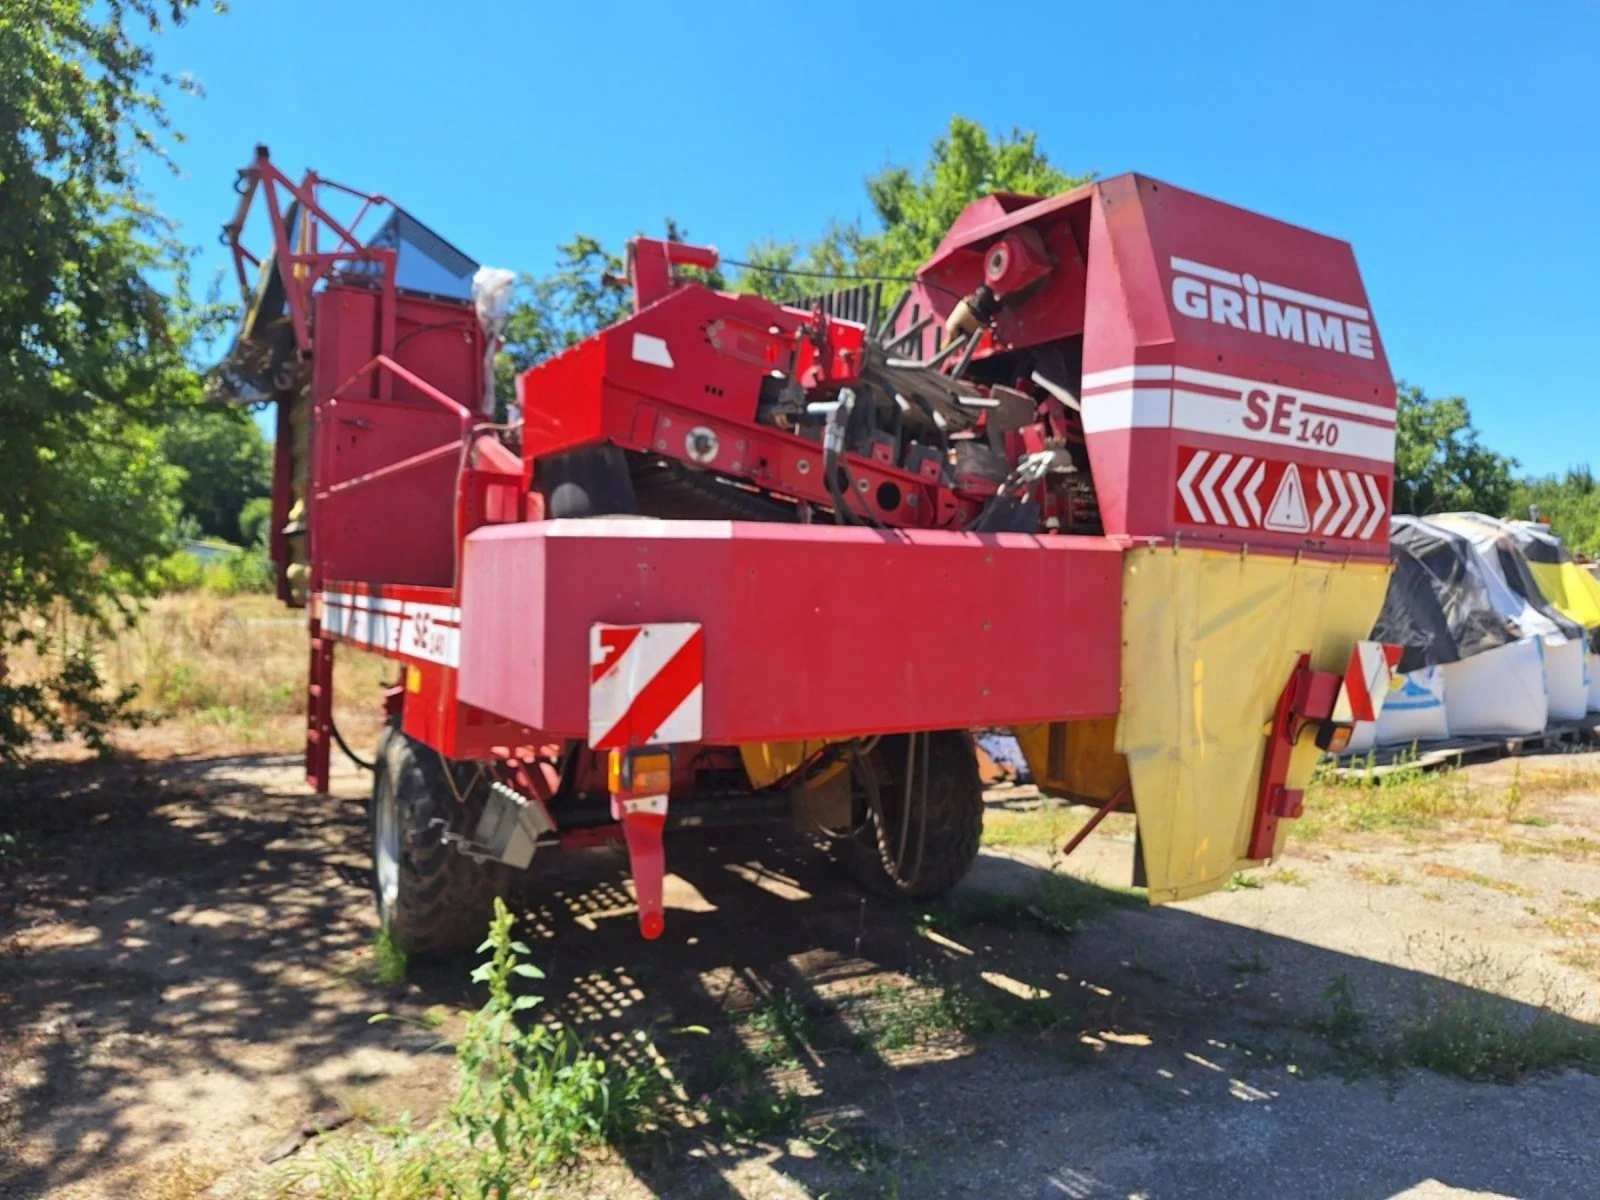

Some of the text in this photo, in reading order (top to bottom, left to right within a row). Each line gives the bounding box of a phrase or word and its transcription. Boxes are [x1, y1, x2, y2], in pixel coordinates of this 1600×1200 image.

[1171, 273, 1375, 360] GRIMME
[1242, 389, 1339, 446] SE 140
[413, 611, 430, 649] SE
